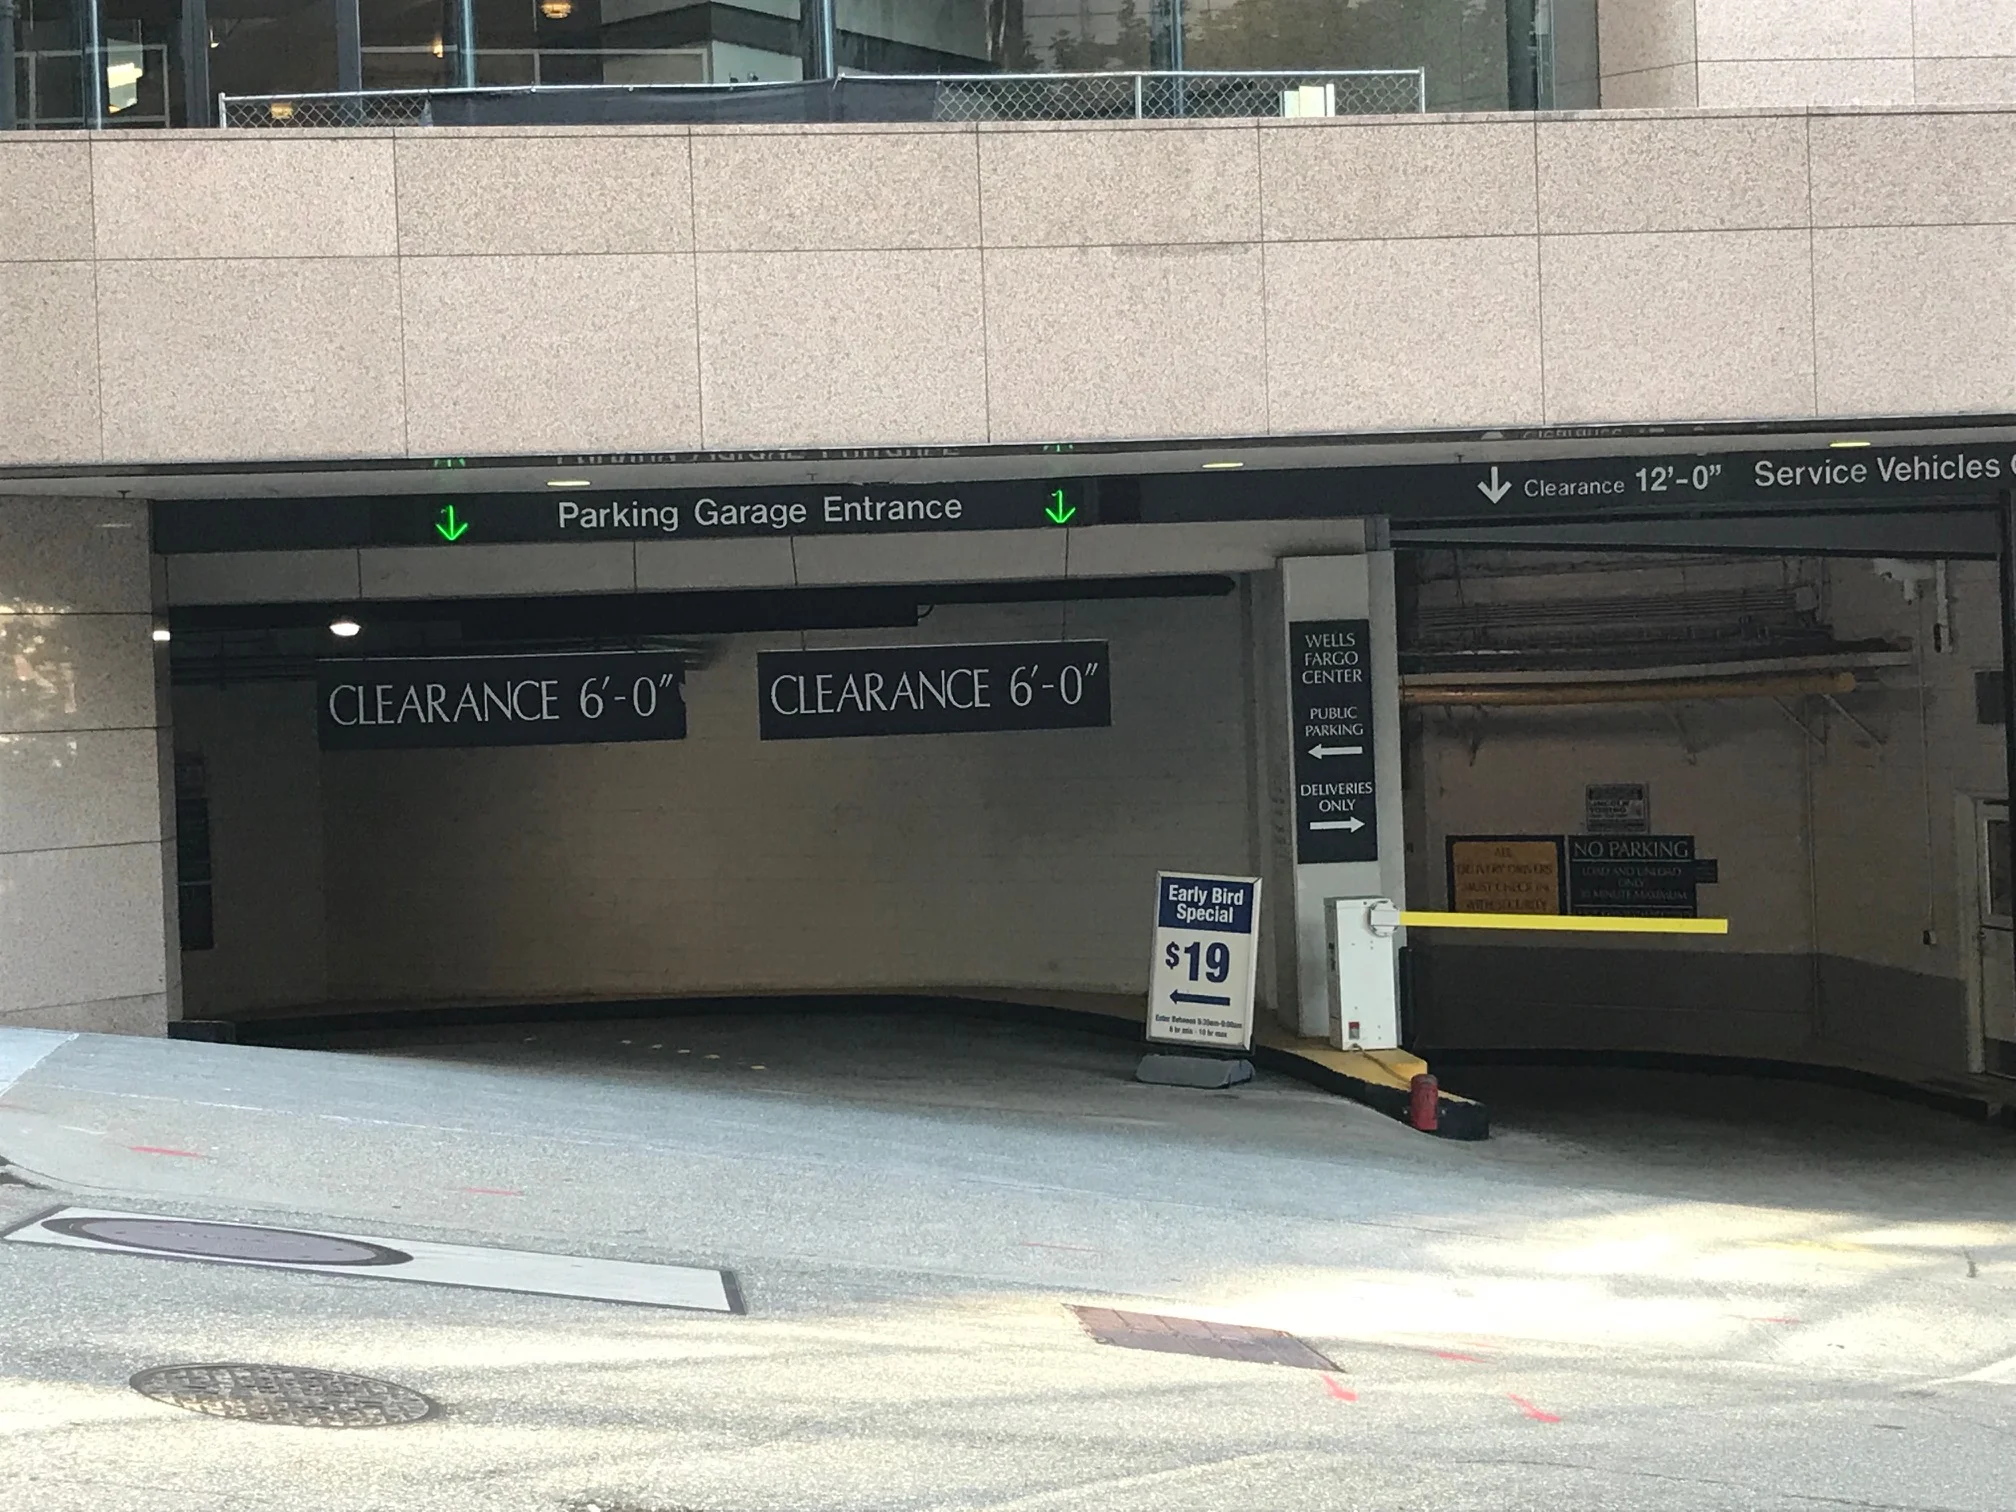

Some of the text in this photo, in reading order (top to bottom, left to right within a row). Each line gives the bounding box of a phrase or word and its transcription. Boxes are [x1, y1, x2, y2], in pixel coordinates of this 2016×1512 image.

[1754, 459, 1868, 488] Service
[1876, 454, 2001, 483] Vehicles
[1523, 478, 1626, 497] Clearance
[558, 496, 963, 531] Parking Garage Entrance
[1305, 632, 1356, 648] WELLS
[1304, 651, 1359, 666] FARGO
[1302, 668, 1363, 684] CENTER
[770, 668, 991, 715] CLEARANCE
[329, 680, 560, 726] CLEARANCE
[1309, 706, 1358, 720] PUBLIC
[1305, 723, 1364, 737] PARKING
[1300, 781, 1374, 797] DELIVERIES
[1318, 798, 1356, 812] ONLY
[1573, 841, 1689, 858] NO PARKING
[1582, 867, 1610, 877] LOAD
[1613, 867, 1635, 877] AND
[1168, 884, 1244, 906] Early Bird
[1176, 902, 1234, 924] Special
[1165, 940, 1230, 984] $19
